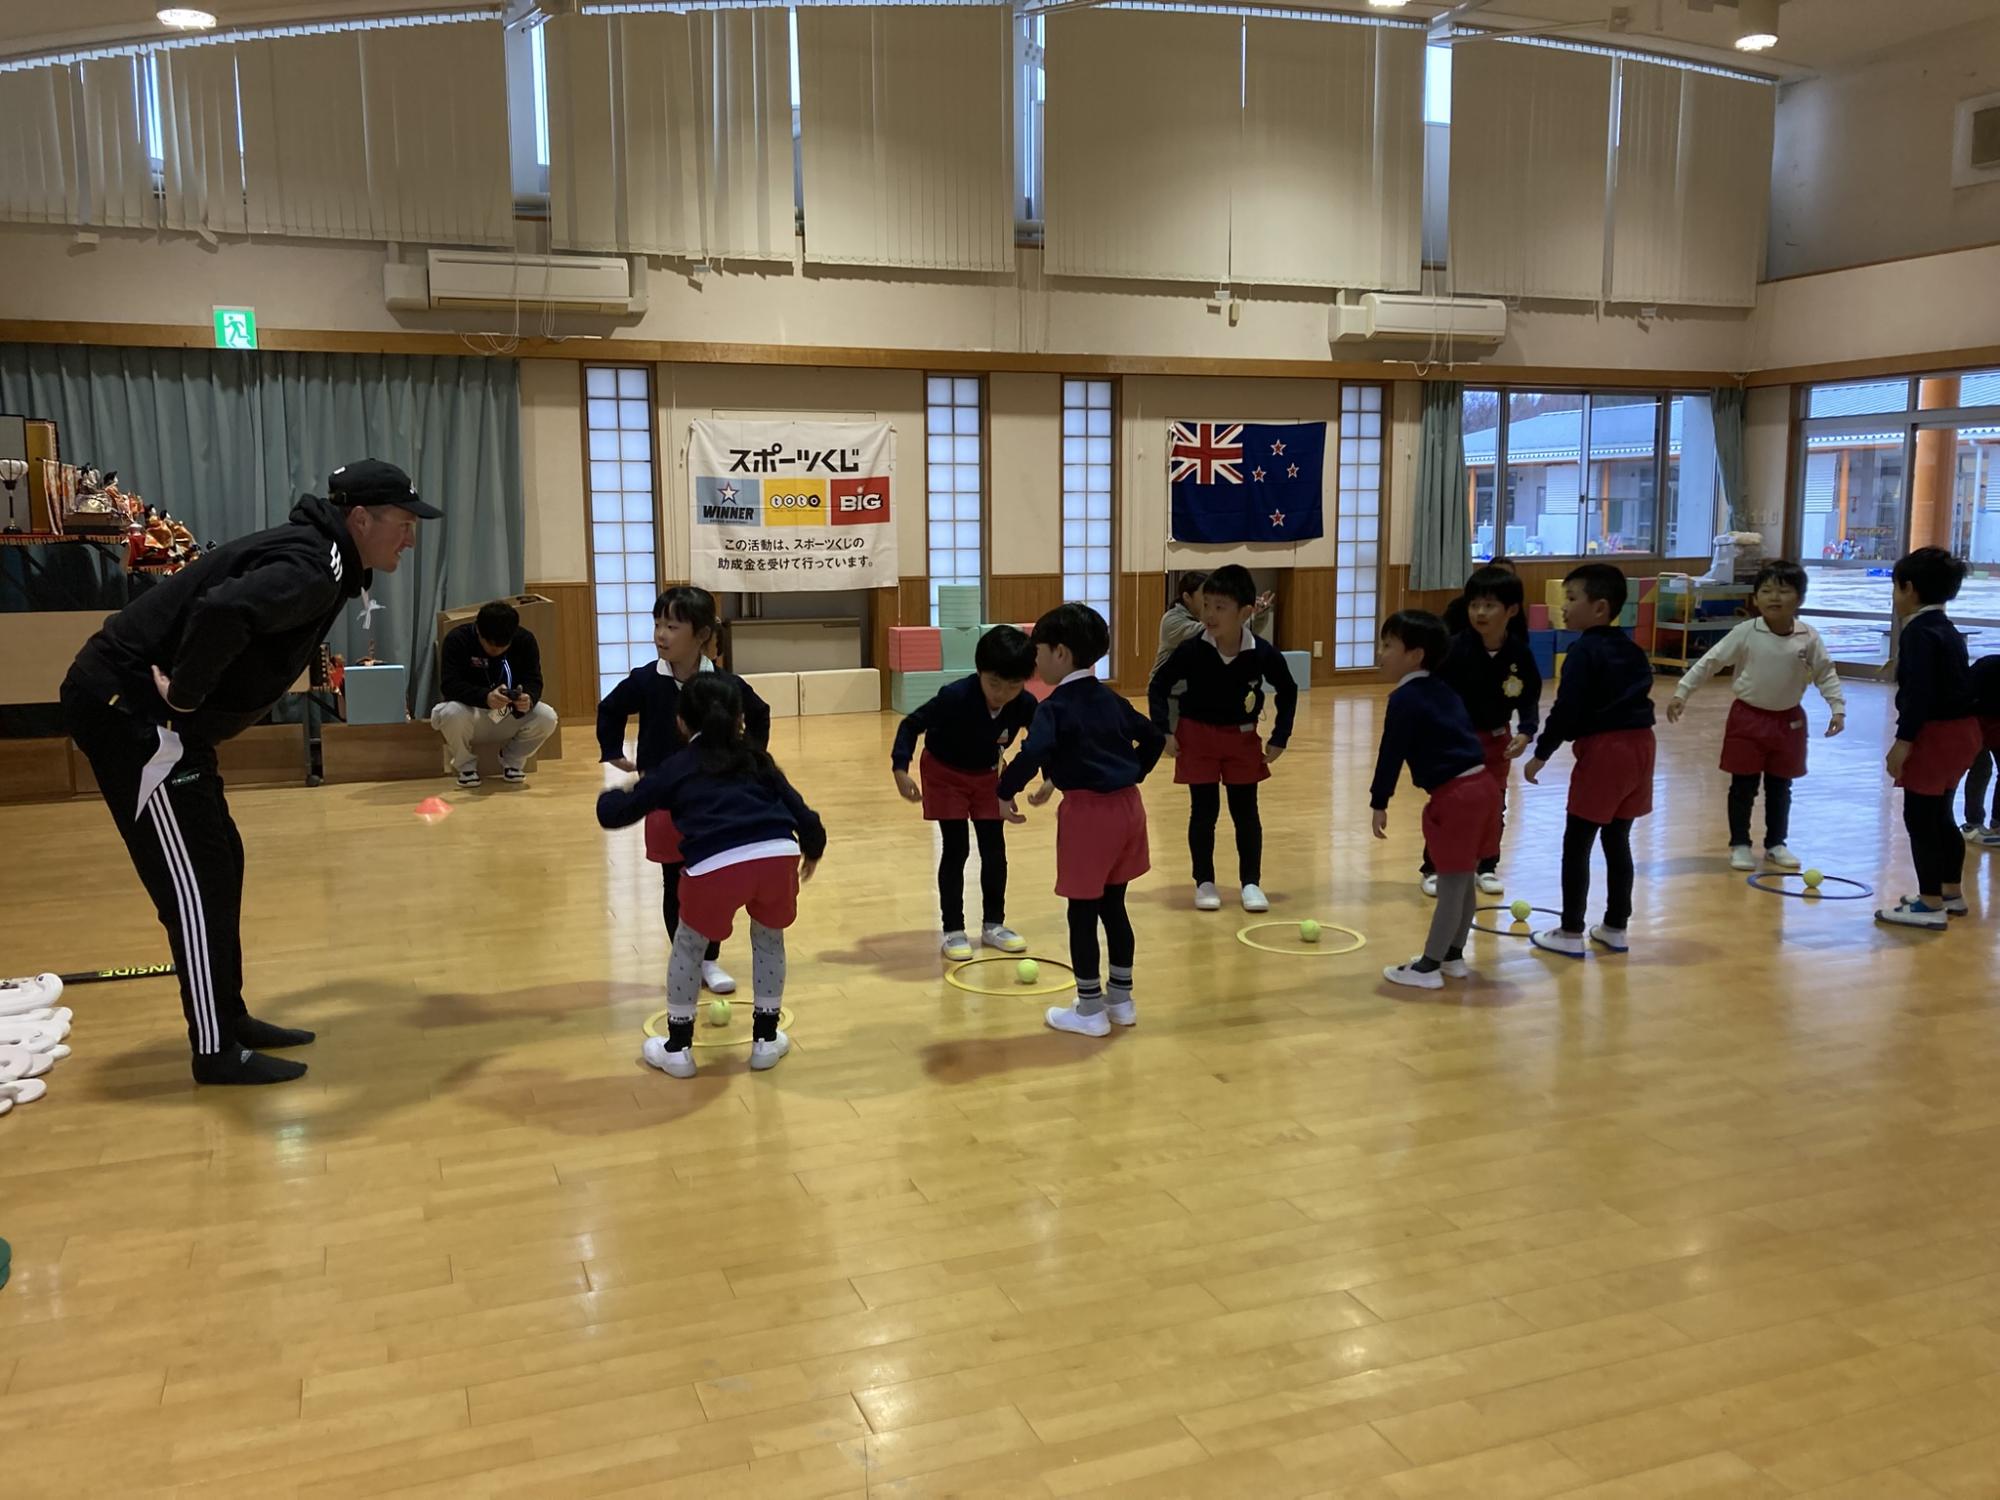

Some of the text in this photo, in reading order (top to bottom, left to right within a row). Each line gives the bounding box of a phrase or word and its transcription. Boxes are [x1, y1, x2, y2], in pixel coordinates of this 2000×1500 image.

[729, 443, 859, 473] スポーツくじ
[770, 494, 821, 508] toto
[703, 505, 754, 520] WINNER
[725, 537, 864, 551] この活動は、スポーツくじの
[718, 556, 873, 571] 助成金を受けて行っています。
[101, 963, 172, 977] INSIDE
